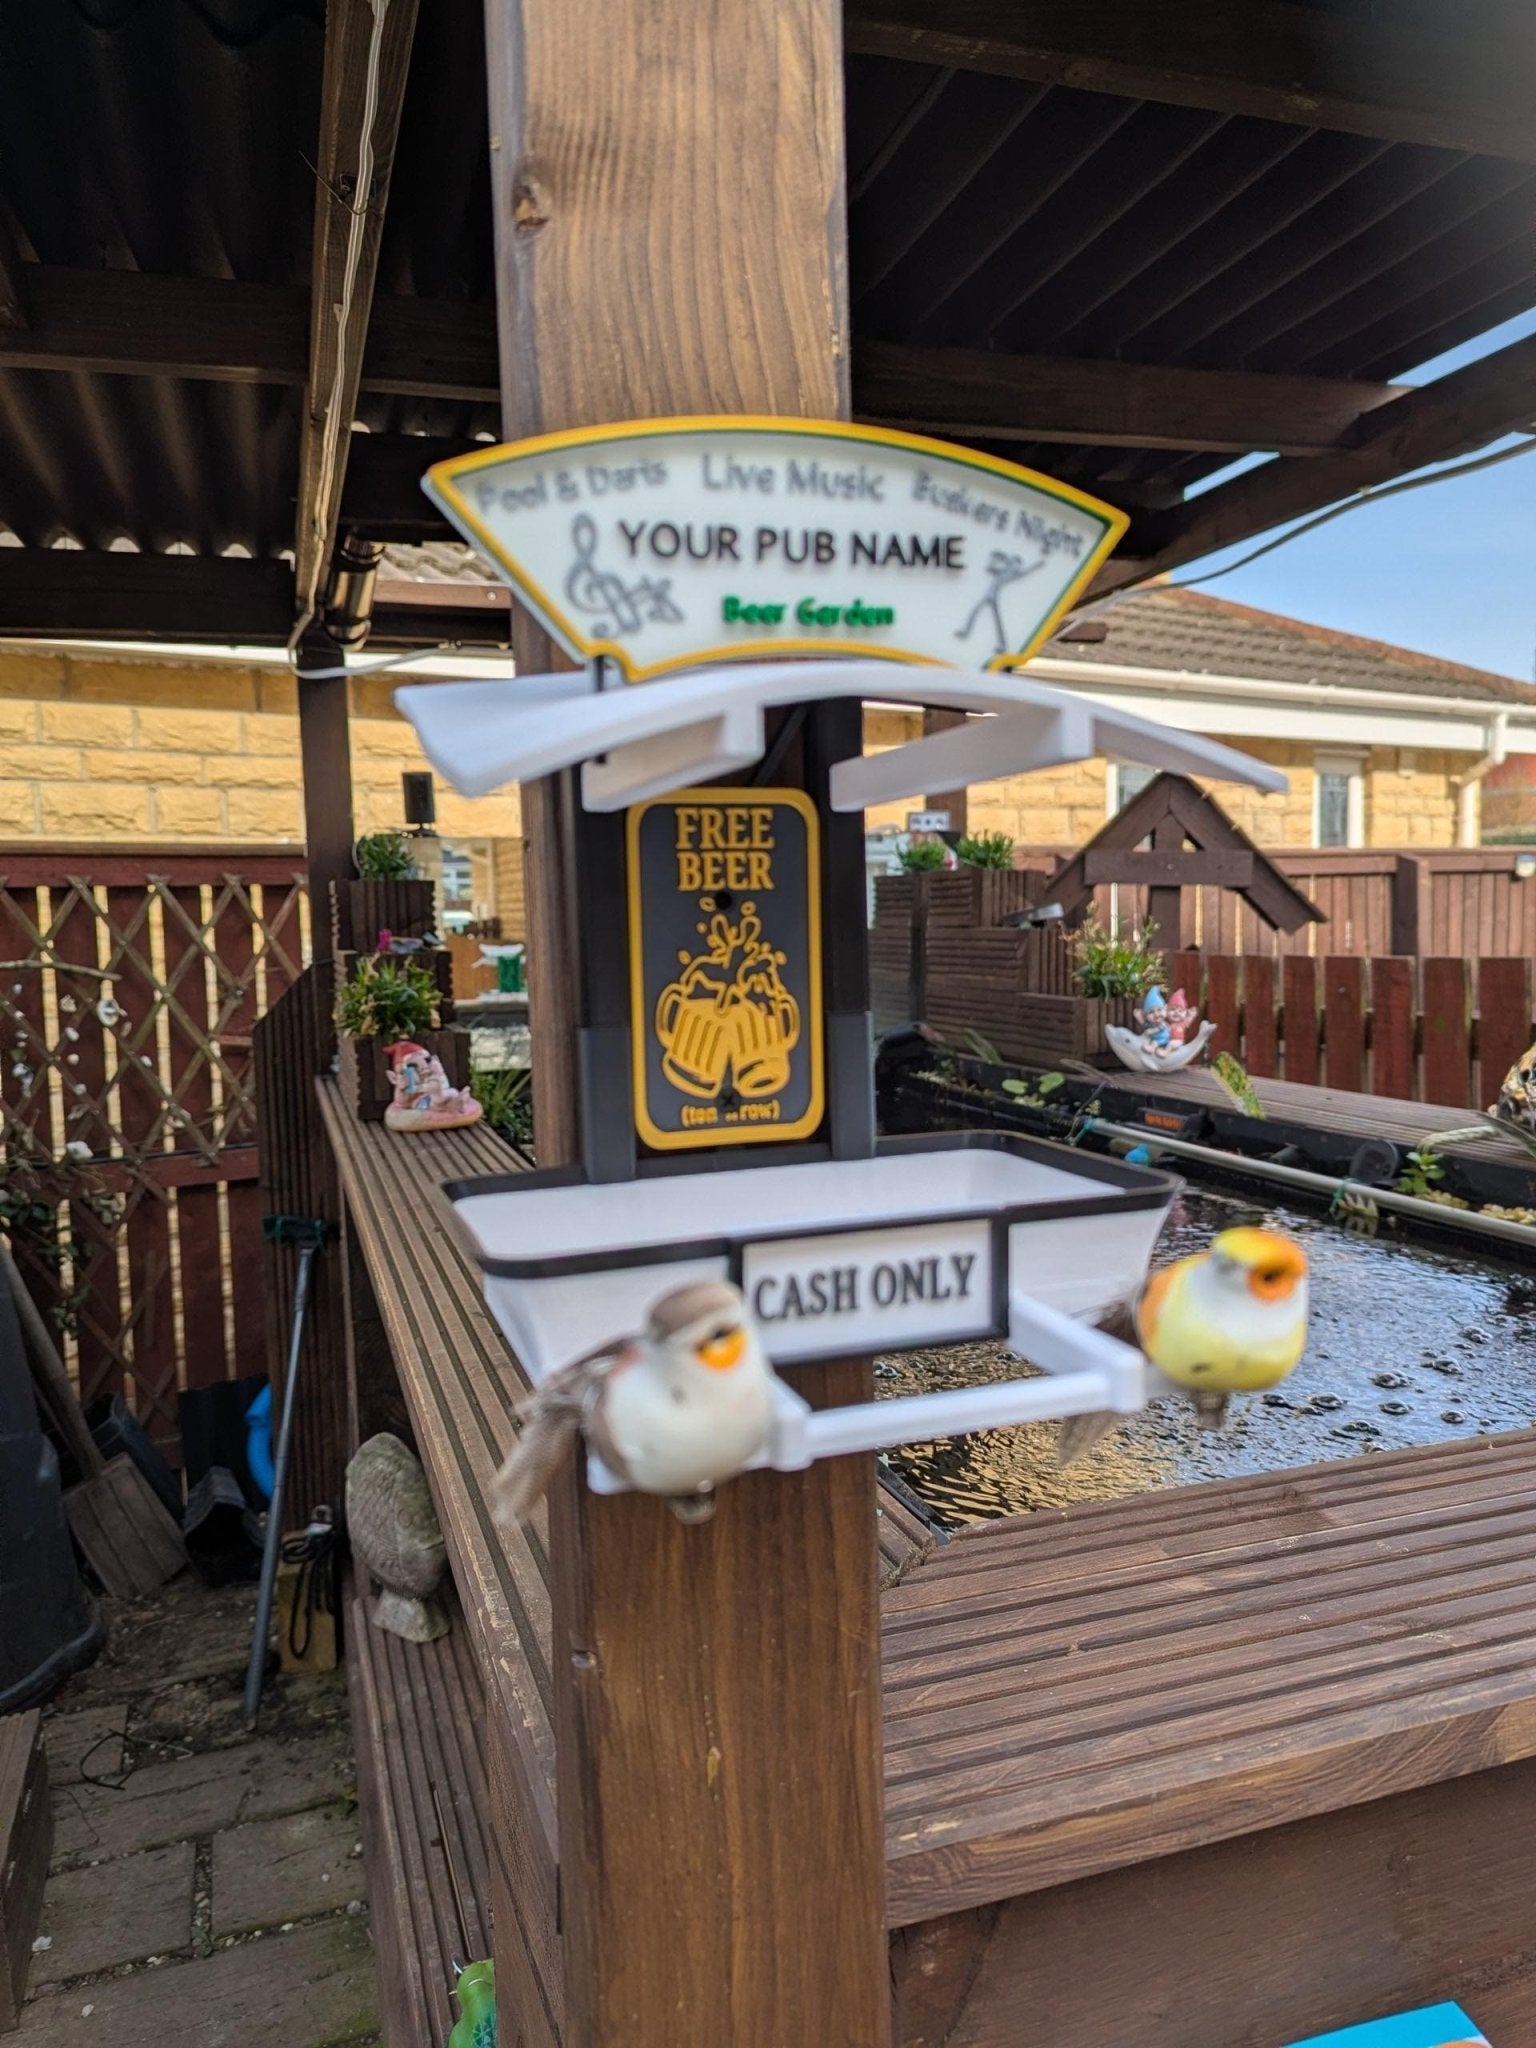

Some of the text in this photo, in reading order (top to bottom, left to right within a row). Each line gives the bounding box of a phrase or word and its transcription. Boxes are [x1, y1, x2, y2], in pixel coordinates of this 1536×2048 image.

[555, 471, 579, 501] &
[702, 454, 774, 494] Live
[786, 460, 884, 501] Music
[1015, 510, 1083, 557] Night
[618, 520, 964, 569] YOUR PUB NAME
[723, 596, 893, 627] Beer Garden
[675, 806, 775, 850] FREE
[677, 851, 775, 891] BEER
[754, 1253, 976, 1320] CASH ONLY
